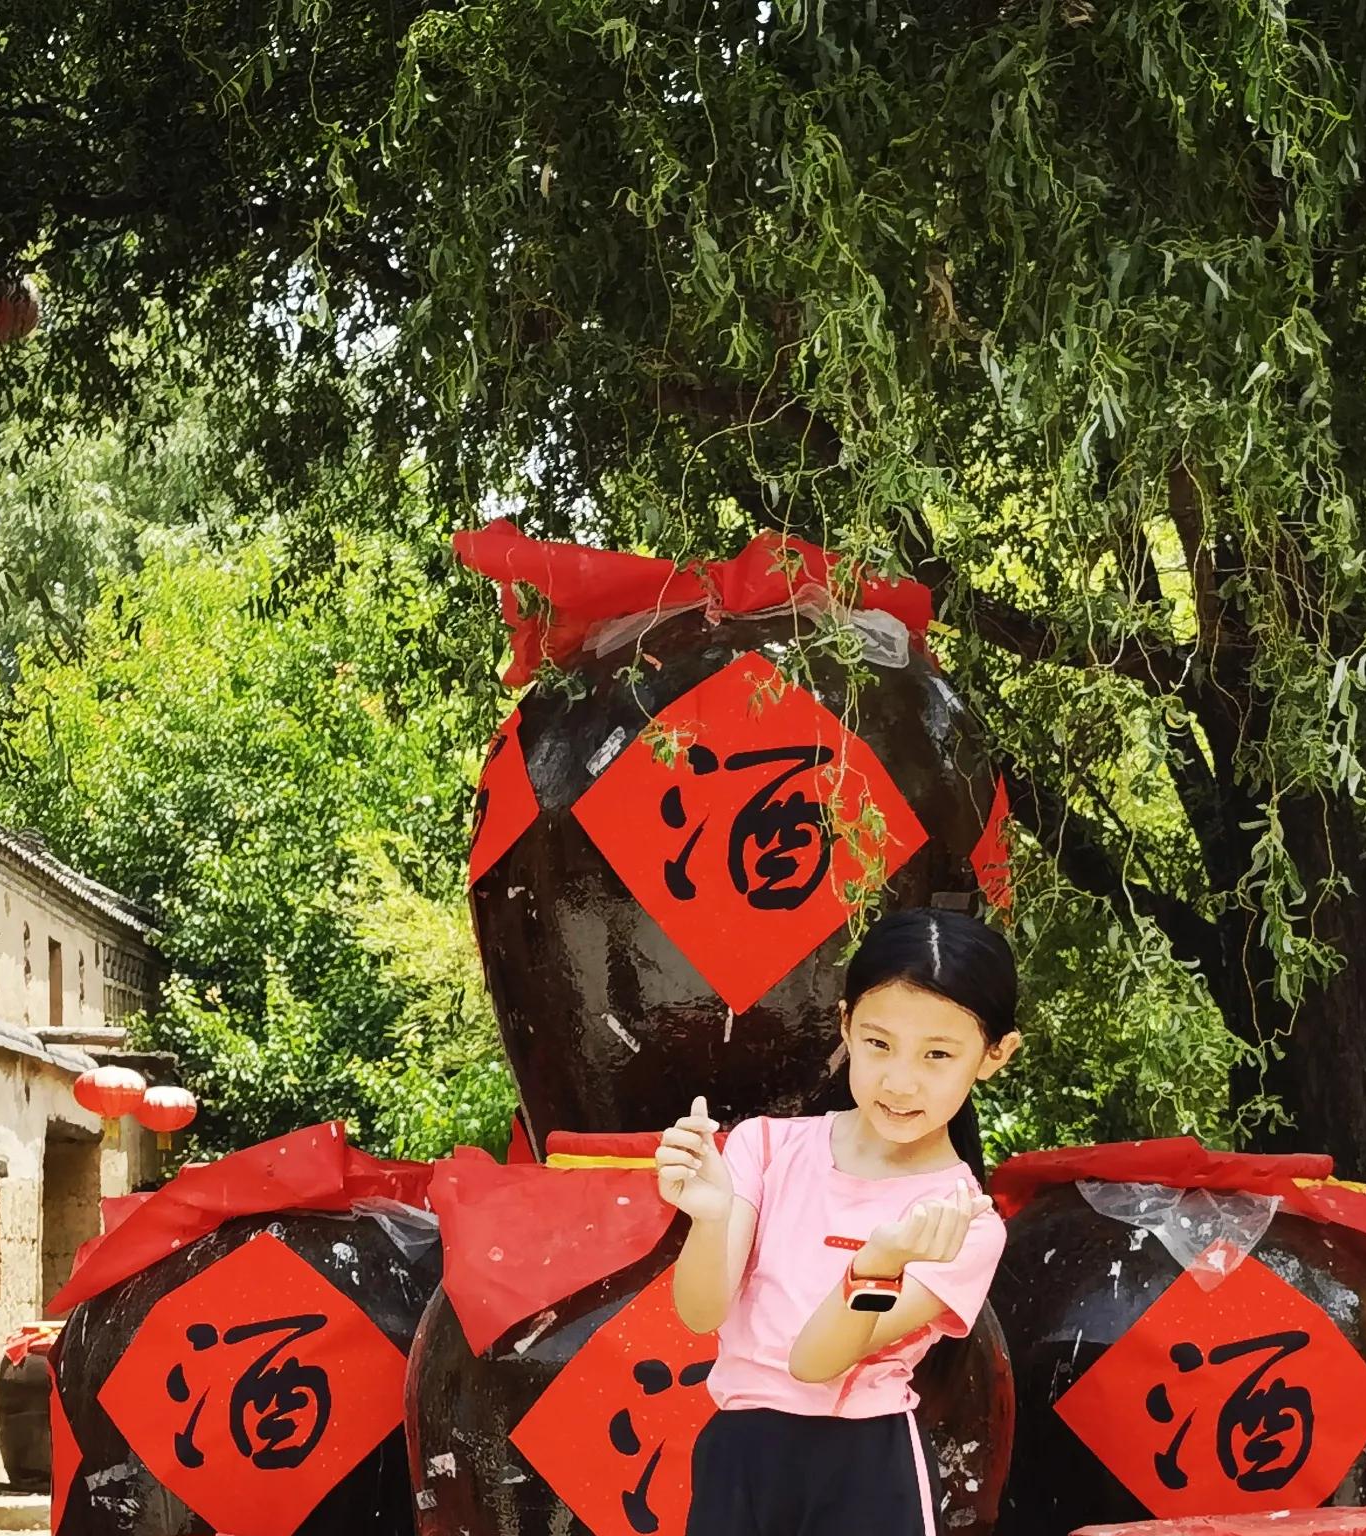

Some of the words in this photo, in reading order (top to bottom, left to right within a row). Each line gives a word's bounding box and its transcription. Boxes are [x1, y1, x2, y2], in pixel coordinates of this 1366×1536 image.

[661, 744, 836, 910] 酒
[167, 1315, 331, 1469] 酒
[1147, 1331, 1314, 1491] 酒
